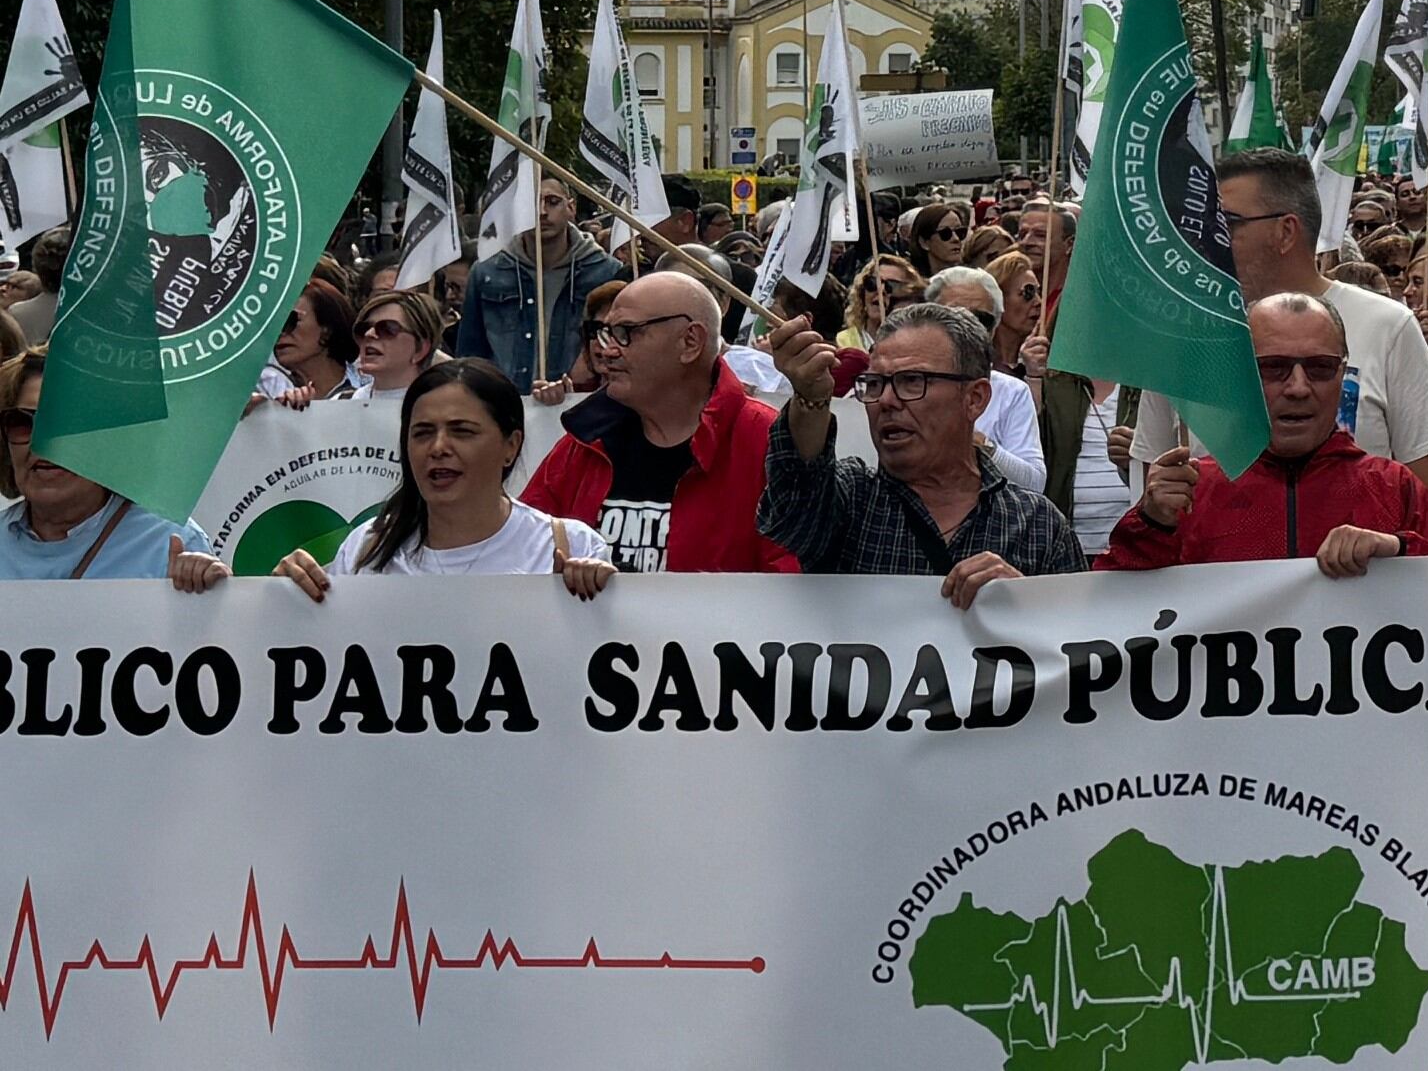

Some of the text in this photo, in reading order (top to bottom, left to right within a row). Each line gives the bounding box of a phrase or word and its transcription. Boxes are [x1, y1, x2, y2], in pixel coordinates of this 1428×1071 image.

[67, 156, 115, 282] DEFENSA
[265, 466, 287, 487] EN
[288, 446, 360, 473] DEFENSA
[365, 446, 385, 460] DE
[283, 464, 402, 493] AGUILAR DE LA FRONT
[267, 642, 539, 735] PARA
[585, 641, 1036, 732] SANIDAD
[872, 802, 1048, 984] COORDINADORA
[1057, 773, 1209, 816] ANDALUZA
[1219, 775, 1257, 800] DE
[1264, 783, 1380, 846] MAREAS
[1267, 957, 1375, 990] CAMB
